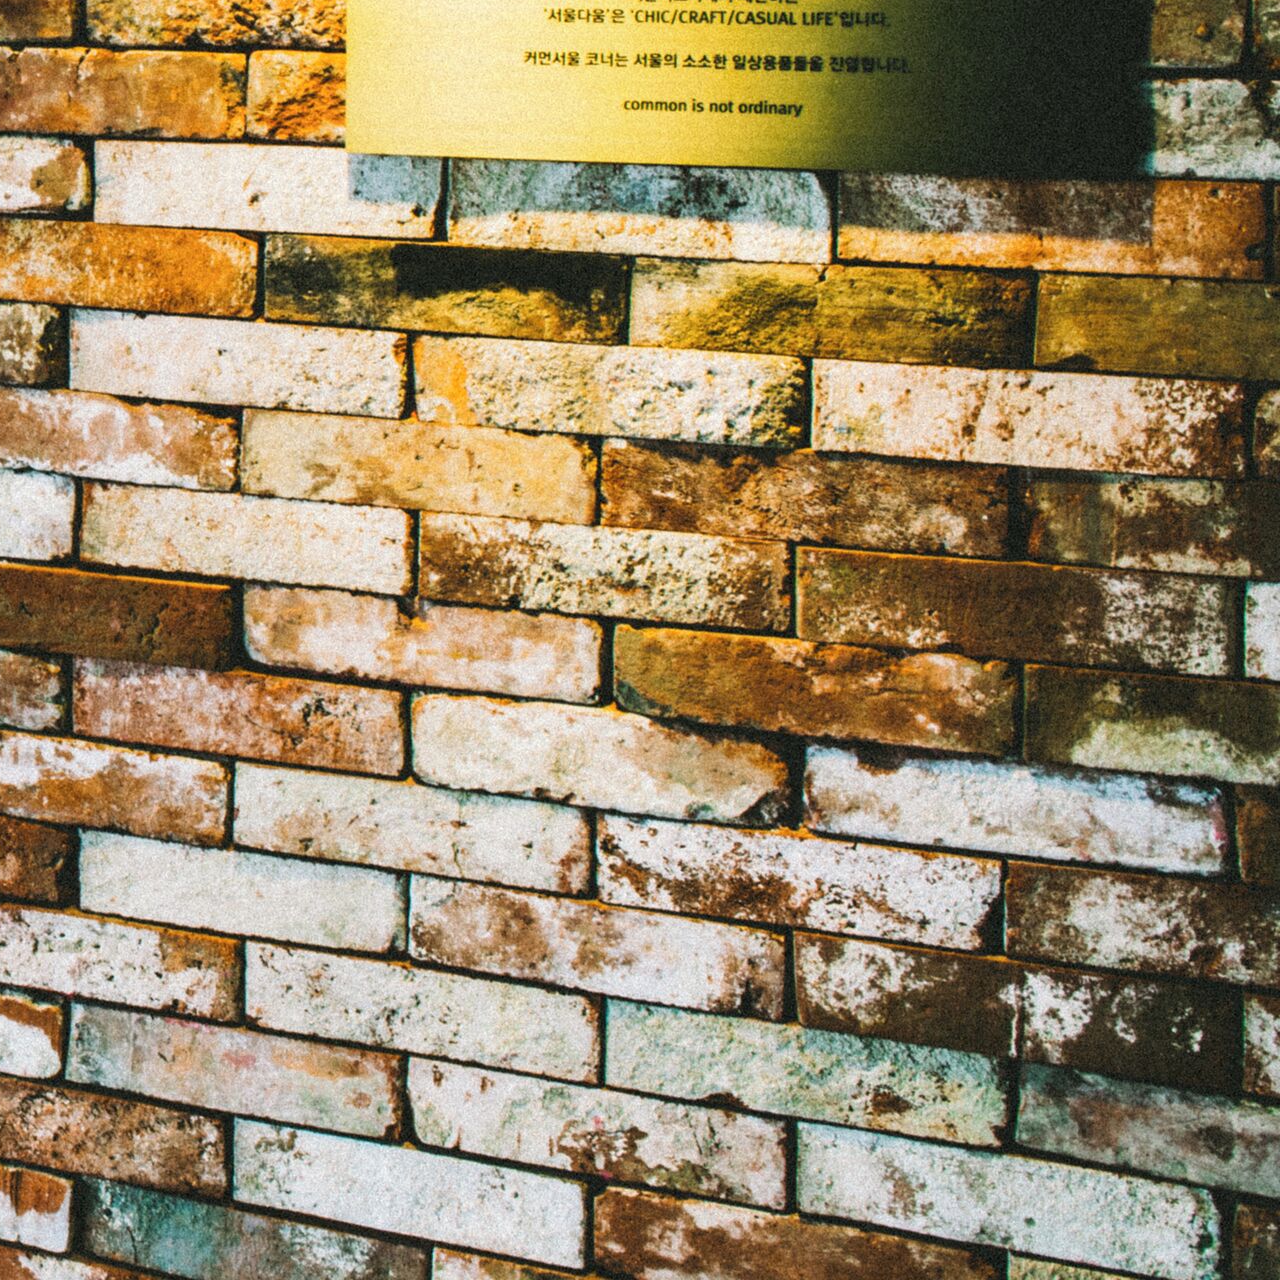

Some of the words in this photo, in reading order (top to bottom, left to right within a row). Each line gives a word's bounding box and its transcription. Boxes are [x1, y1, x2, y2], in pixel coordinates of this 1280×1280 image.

[523, 50, 581, 67] 커먼서울
[585, 51, 629, 68] 코너는
[633, 52, 679, 69] 서울의
[682, 53, 727, 70] 소소한
[732, 54, 824, 71] 일상용품들을
[623, 100, 688, 112] common
[691, 98, 705, 112] is
[709, 100, 734, 113] not
[738, 99, 804, 117] ordinary
